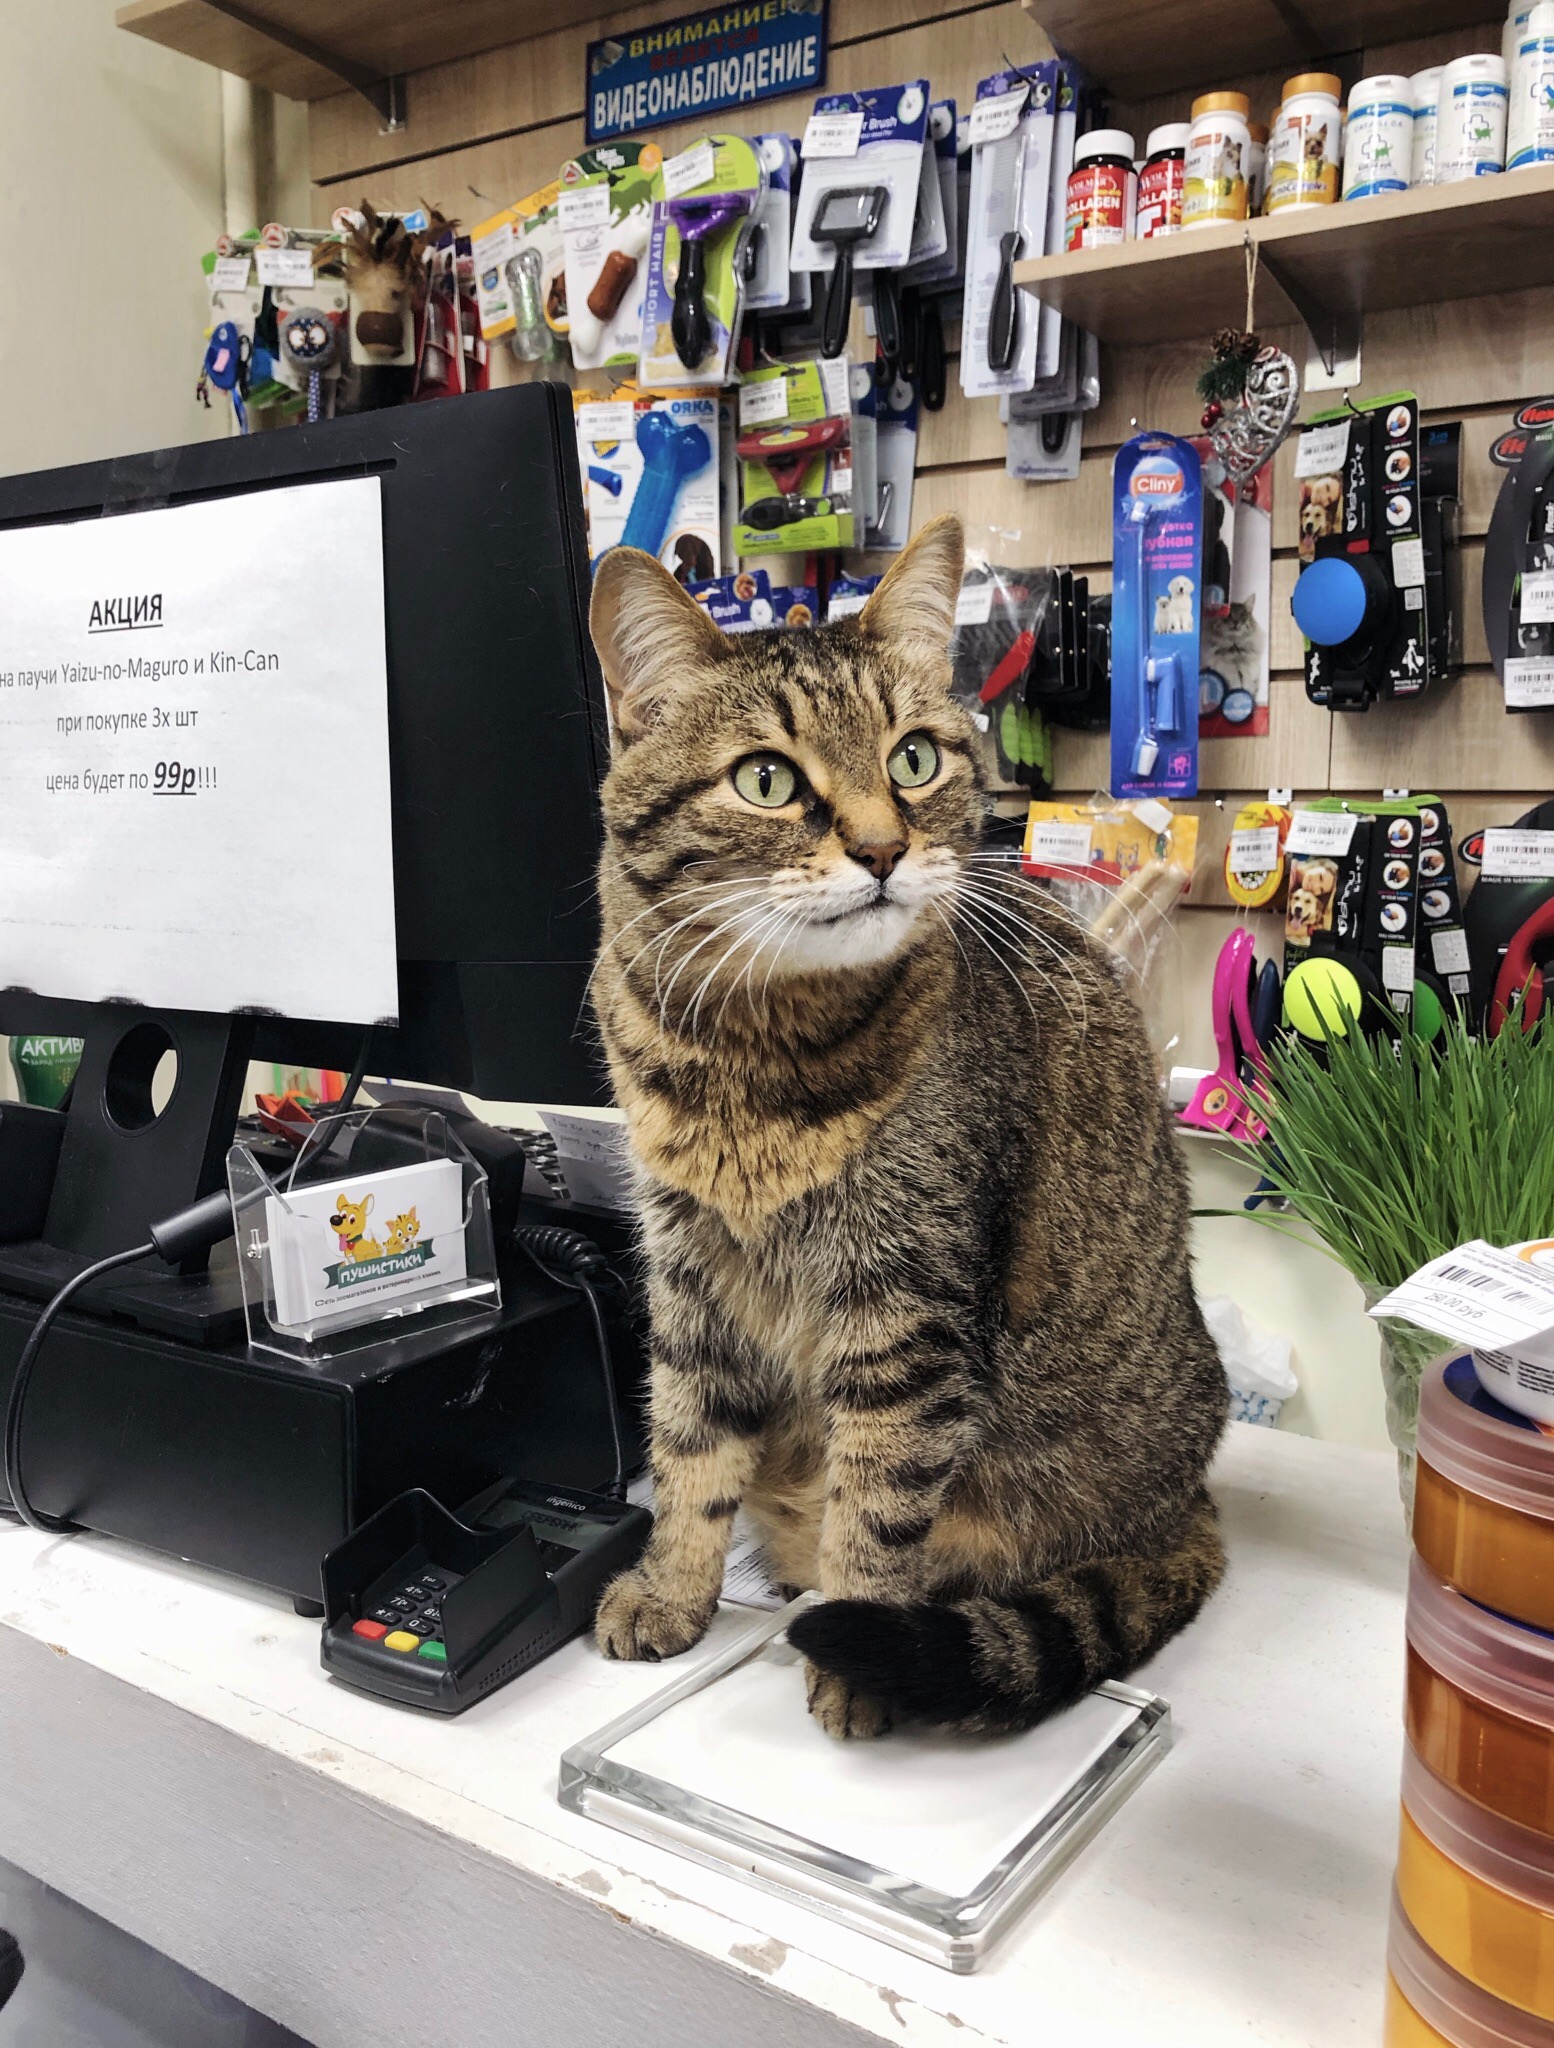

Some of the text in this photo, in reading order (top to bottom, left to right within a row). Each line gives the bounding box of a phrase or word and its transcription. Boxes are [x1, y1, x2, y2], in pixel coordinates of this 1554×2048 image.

[629, 0, 788, 58] ВНИМАНИЕ!
[651, 27, 760, 71] ВЕДЕТСЯ
[593, 34, 818, 131] ВИДЕОНАБЛЮДЕНИЕ
[646, 232, 664, 333] SHORT HAIR
[671, 400, 714, 414] ORKA
[1137, 477, 1176, 493] Cliny
[88, 593, 163, 629] АКЦИЯ
[0, 649, 280, 690] на паучи Yaizu-no-Maguro и Kin-Can
[57, 715, 82, 736] при
[86, 712, 148, 734] покупке
[175, 710, 199, 727] шт
[46, 772, 80, 793] цена
[83, 768, 126, 792] будет
[129, 773, 149, 790] по
[1424, 1292, 1487, 1320] 250.00 руб
[546, 1496, 586, 1511] ingenico
